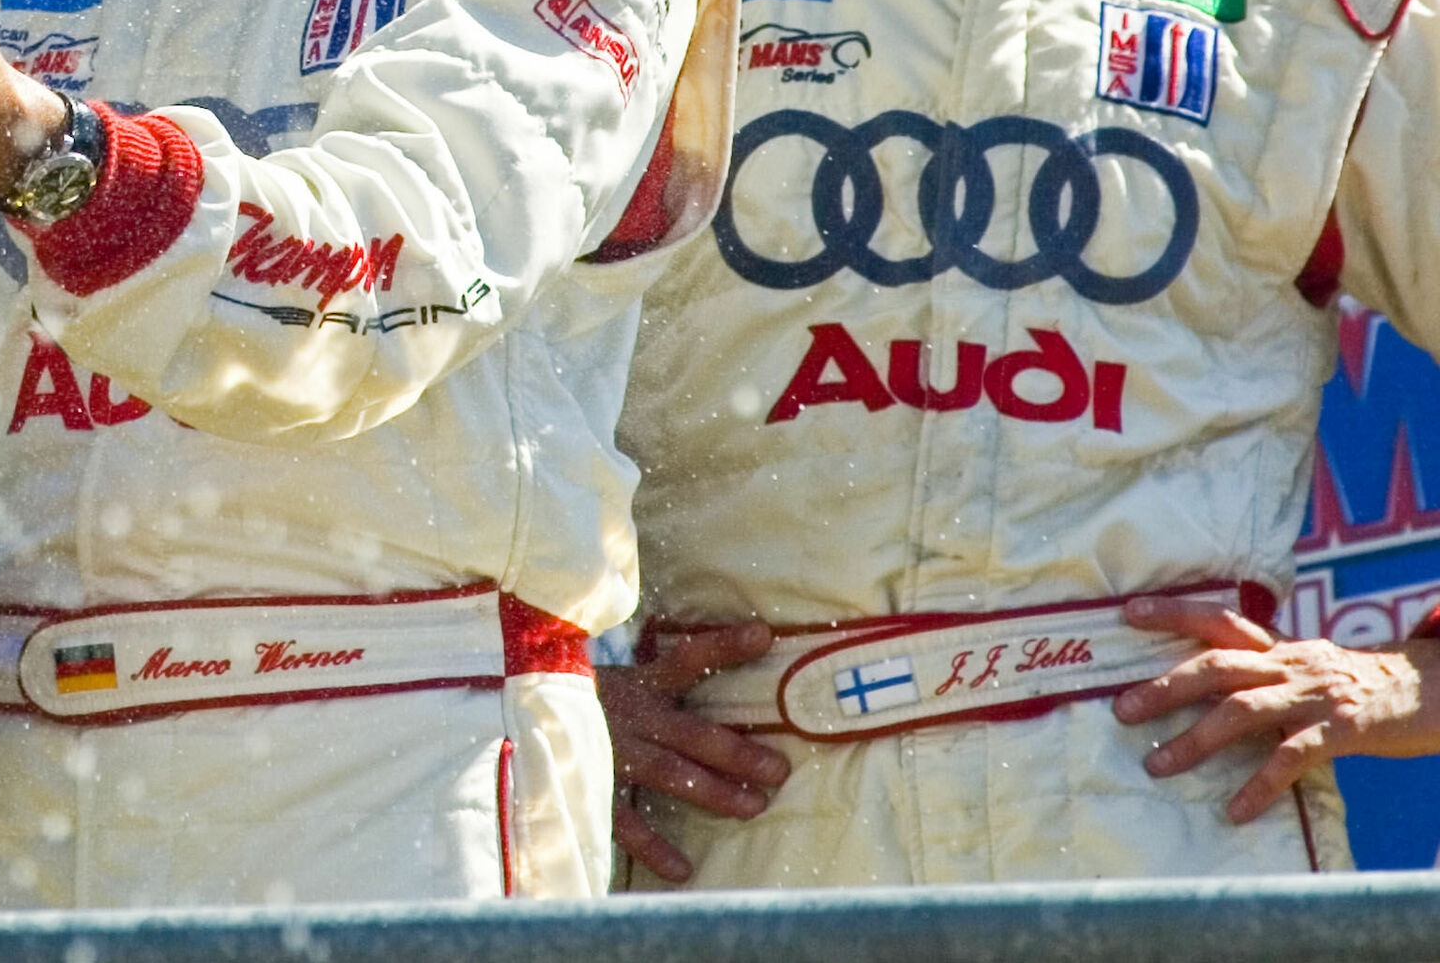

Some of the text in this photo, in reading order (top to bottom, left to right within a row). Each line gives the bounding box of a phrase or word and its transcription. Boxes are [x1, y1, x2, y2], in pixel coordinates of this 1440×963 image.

[748, 41, 824, 70] MANS
[1106, 12, 1139, 98] IMSA
[780, 68, 836, 84] Series
[766, 323, 1127, 434] Audi
[130, 640, 366, 681] Marco Werner
[1014, 637, 1094, 673] Lehto
